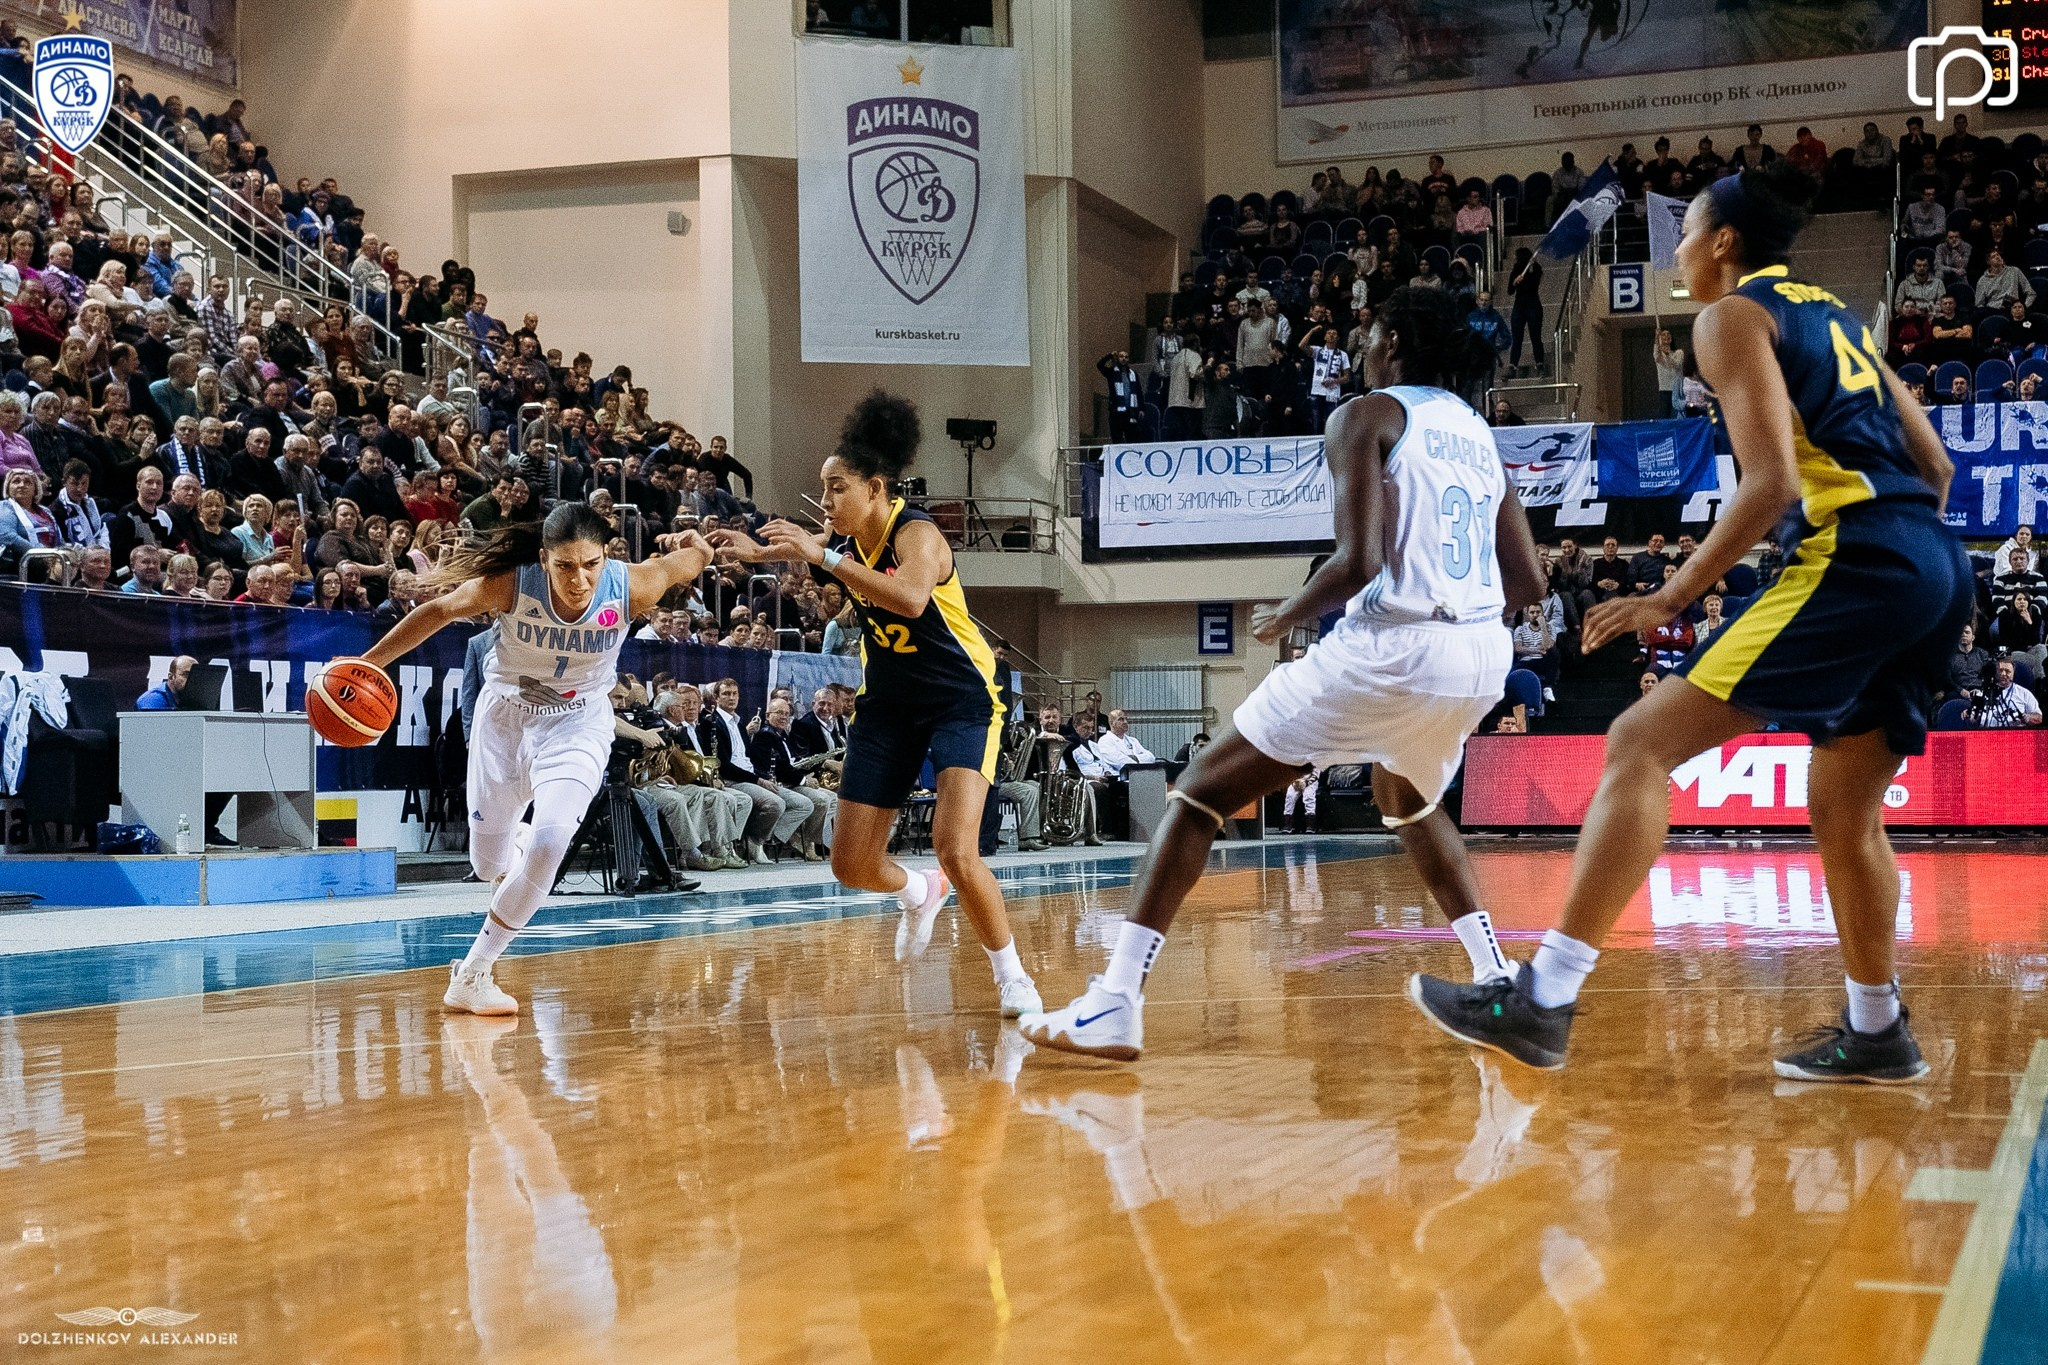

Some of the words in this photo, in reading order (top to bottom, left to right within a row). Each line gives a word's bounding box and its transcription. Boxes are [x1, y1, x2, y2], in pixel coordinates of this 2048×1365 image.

[1992, 67, 2010, 81] 31
[1533, 96, 1647, 119] Генеральный
[1651, 92, 1723, 108] спонсор
[1727, 86, 1752, 101] БК
[1755, 80, 1848, 100] «Динамо»
[854, 103, 973, 138] ДИНАМО
[881, 240, 952, 259] КУРСК
[875, 329, 961, 341] kurskbasket.ru
[1922, 401, 2048, 453] UR
[1424, 428, 1496, 479] CHARLES
[1639, 467, 1680, 478] КУРСКИЙ
[1115, 494, 1130, 513] НЕ
[1134, 493, 1173, 512] МОЖЕМ
[1247, 489, 1257, 508] С
[1295, 482, 1326, 505] ГОДА
[1442, 485, 1492, 586] 31
[517, 620, 619, 654] DYNAMO
[868, 616, 918, 654] 32
[553, 655, 570, 679] 1
[350, 667, 394, 704] molten
[500, 695, 587, 716] talloinvest
[1890, 790, 1902, 802] ТВ
